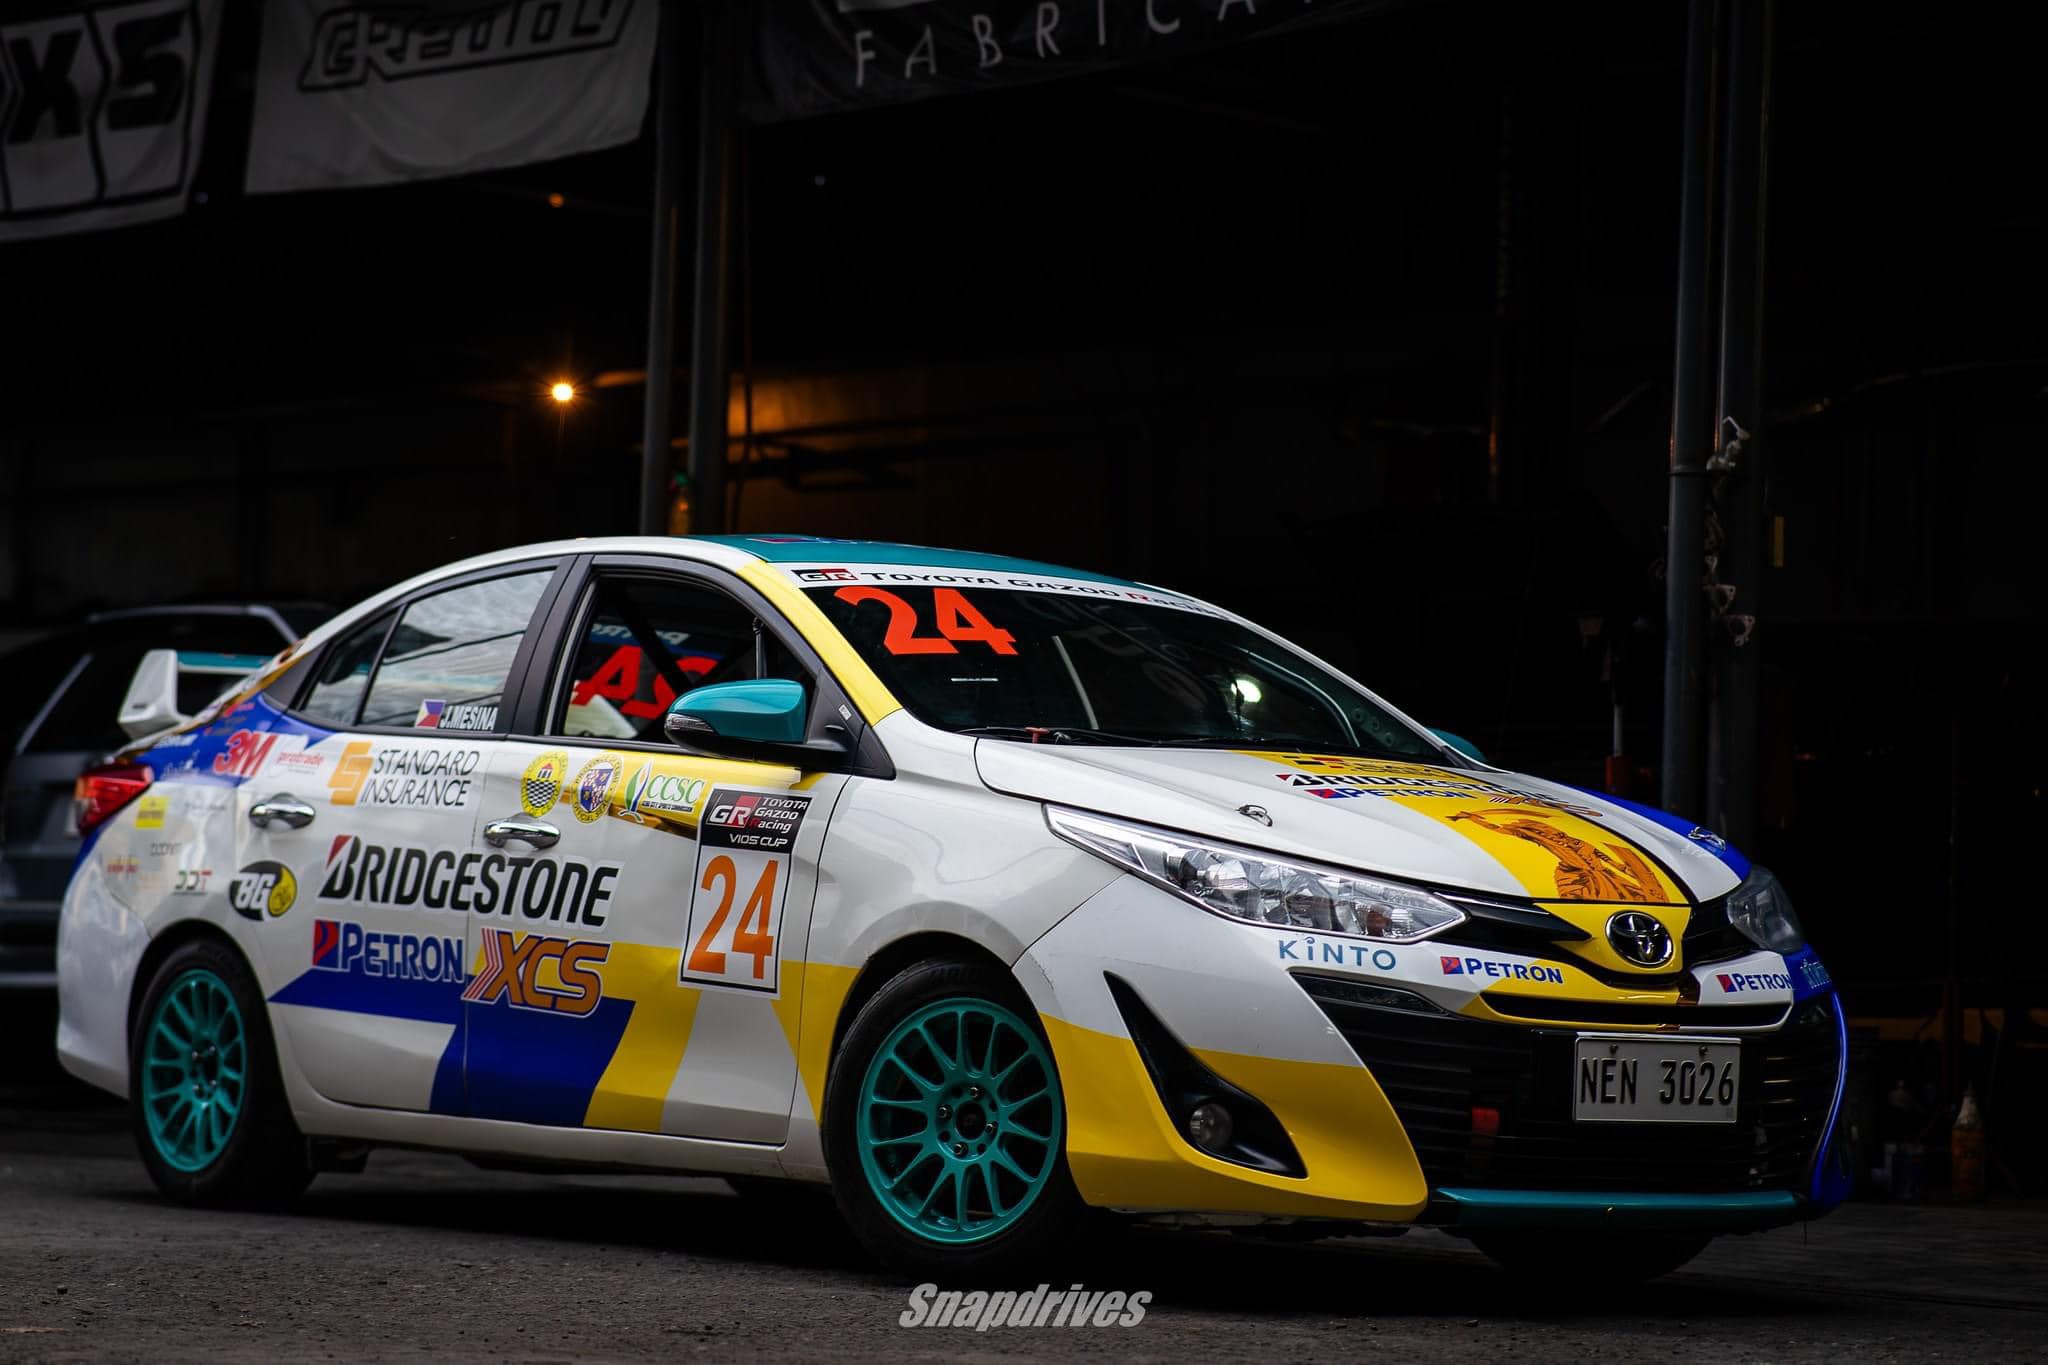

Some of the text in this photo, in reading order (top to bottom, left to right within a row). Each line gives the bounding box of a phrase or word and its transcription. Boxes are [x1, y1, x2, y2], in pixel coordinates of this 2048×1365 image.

[797, 570, 859, 583] GR
[861, 572, 1000, 585] TOYOTA
[1007, 579, 1120, 597] GAZOO
[834, 585, 1018, 655] 24
[440, 705, 499, 731] J.MESINA
[213, 729, 279, 777] 3M
[373, 750, 480, 776] STANDARD
[360, 779, 473, 807] INSURANCE
[646, 774, 705, 804] CCSC
[709, 804, 752, 826] GR
[754, 807, 799, 820] GAZOO
[761, 797, 808, 810] TOYOTA
[750, 818, 793, 834] Racing
[729, 833, 789, 847] VIOS CUP
[318, 835, 620, 927] BRIDGESTONE
[687, 855, 779, 980] 24
[482, 929, 612, 1018] XCS
[1580, 1056, 1735, 1106] NEN 3026
